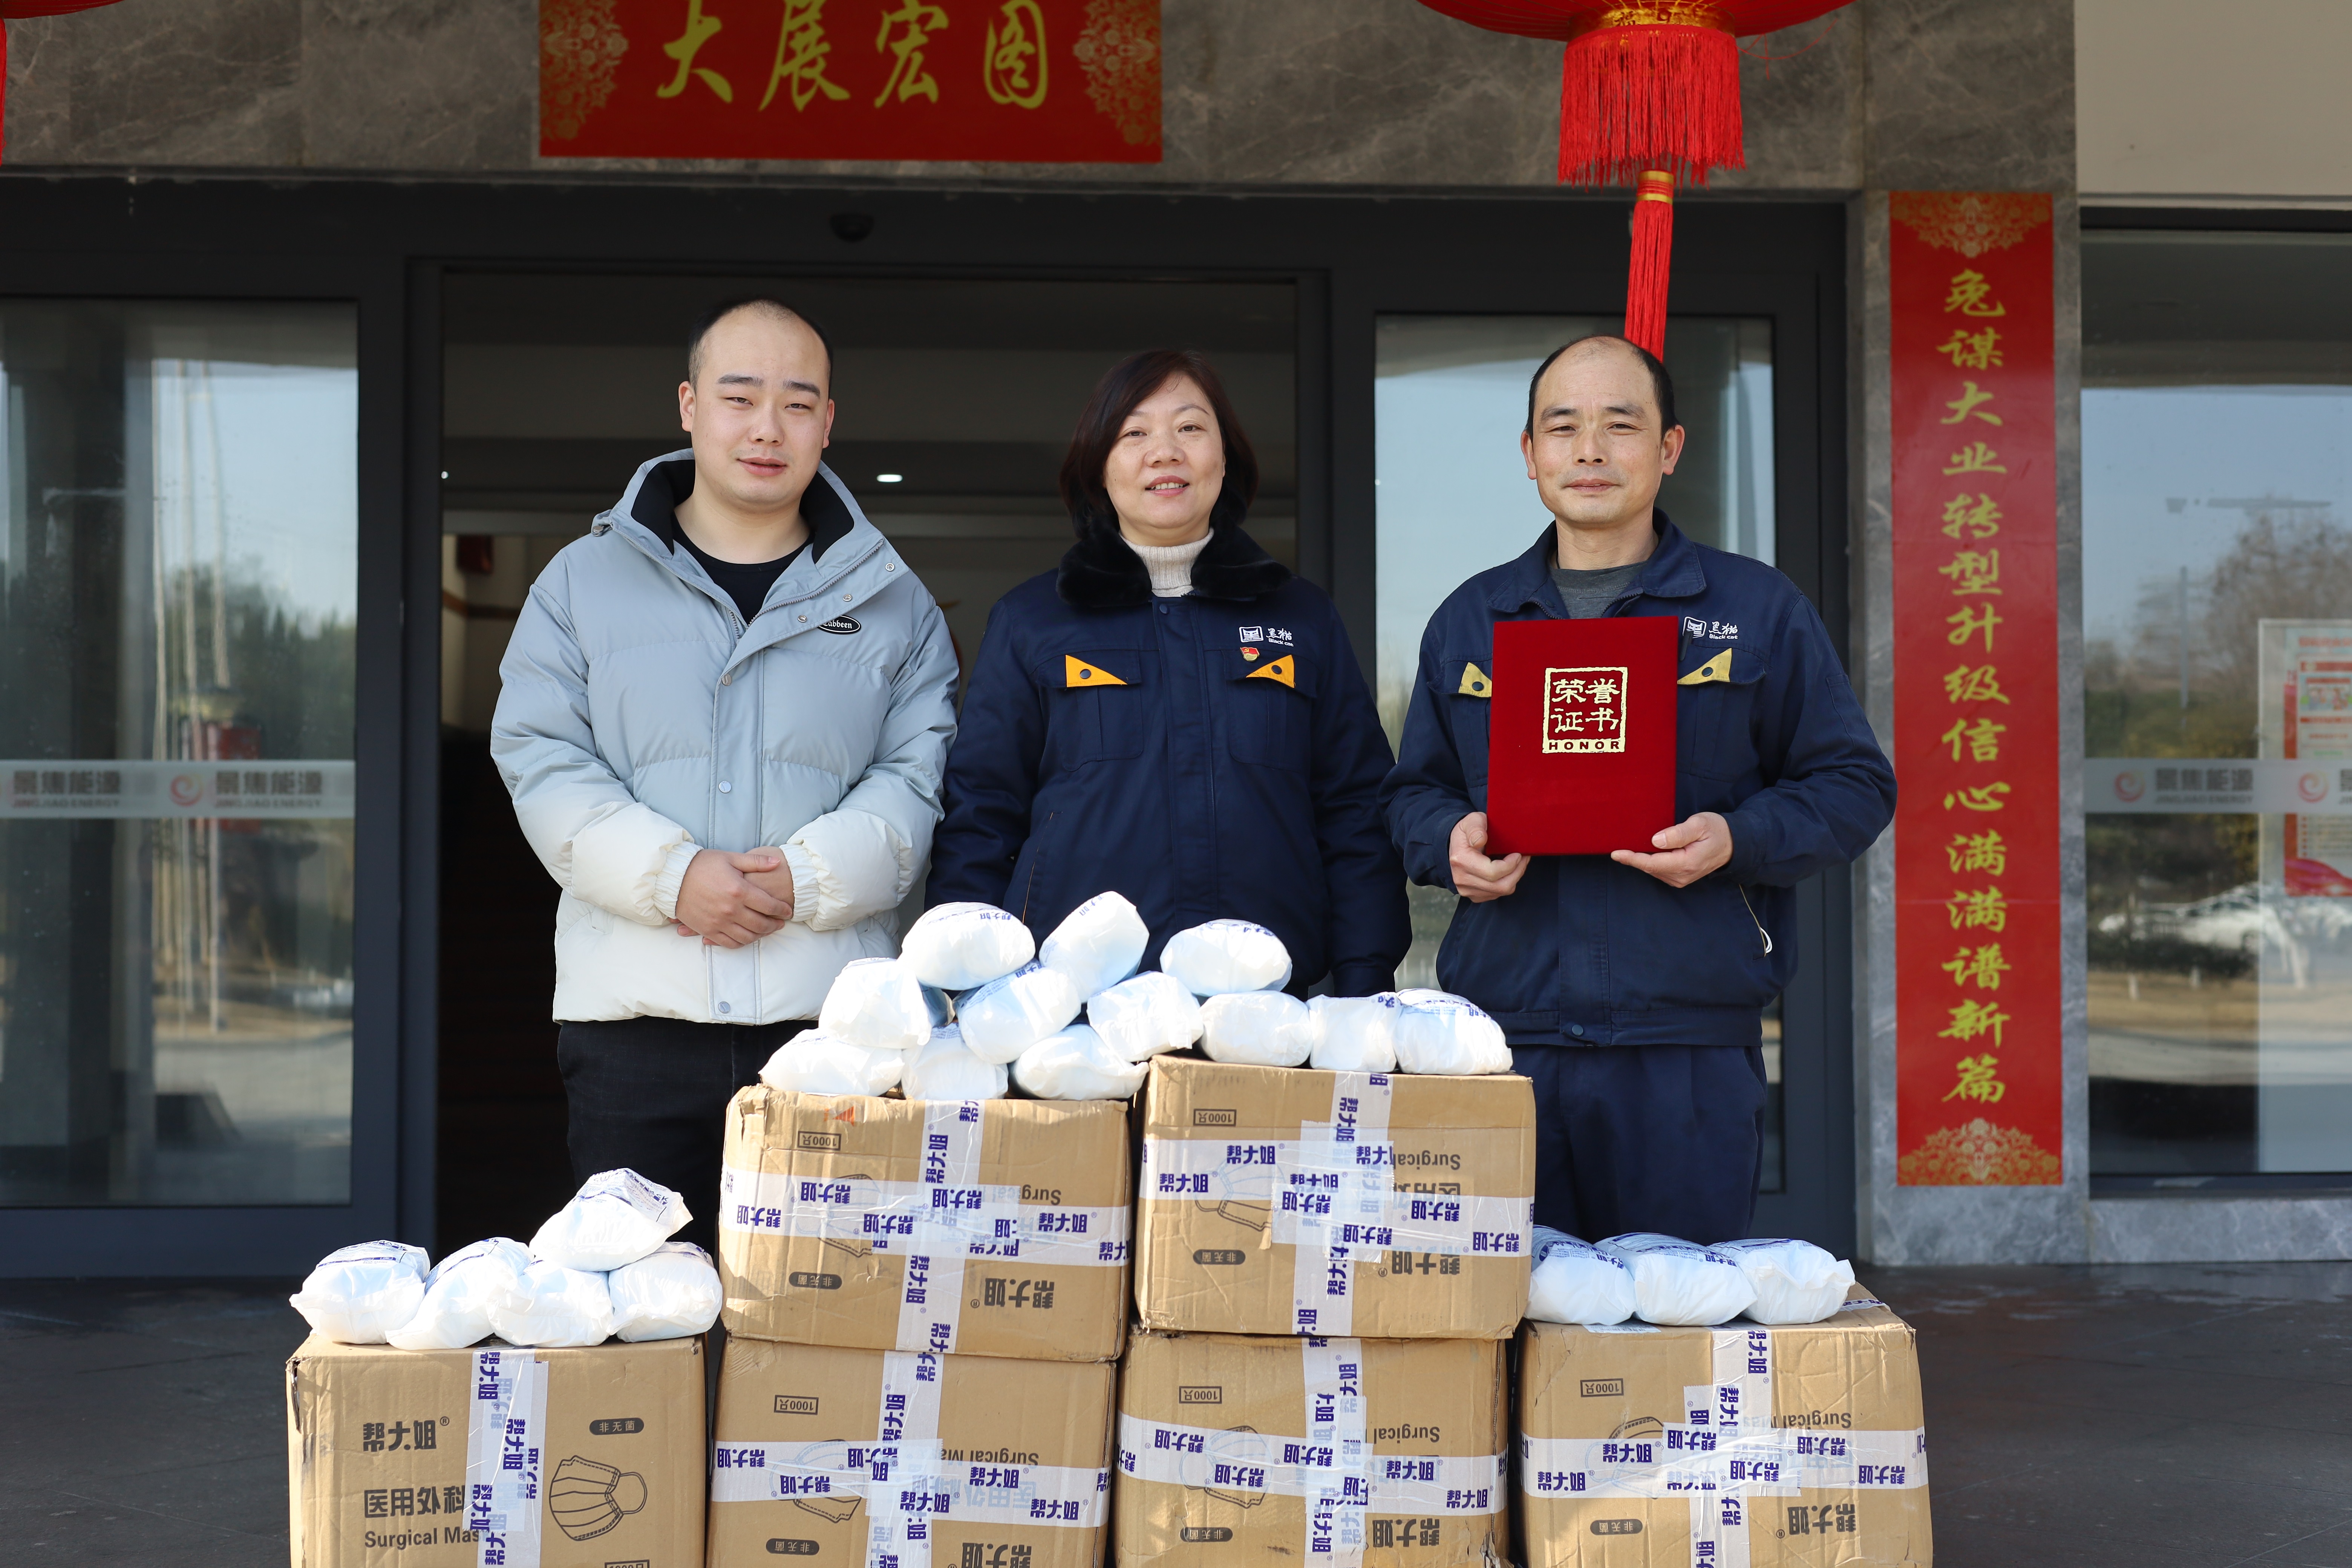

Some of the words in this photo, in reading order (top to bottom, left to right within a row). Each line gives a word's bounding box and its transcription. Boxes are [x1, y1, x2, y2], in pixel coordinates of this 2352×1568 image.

[1552, 678, 1620, 704] 荣誉
[1551, 708, 1619, 733] 证书
[1549, 741, 1619, 750] HONOR
[984, 1278, 1055, 1309] 帮大姐
[599, 1420, 635, 1432] 非无菌
[1783, 1410, 1851, 1429] Surgical
[363, 1420, 436, 1452] 帮大姐
[1374, 1424, 1440, 1444] Surgical
[1788, 1503, 1856, 1535] 帮大姐
[364, 1527, 438, 1550] Surgical
[444, 1528, 481, 1543] Mas
[1373, 1518, 1440, 1547] 帮大姐
